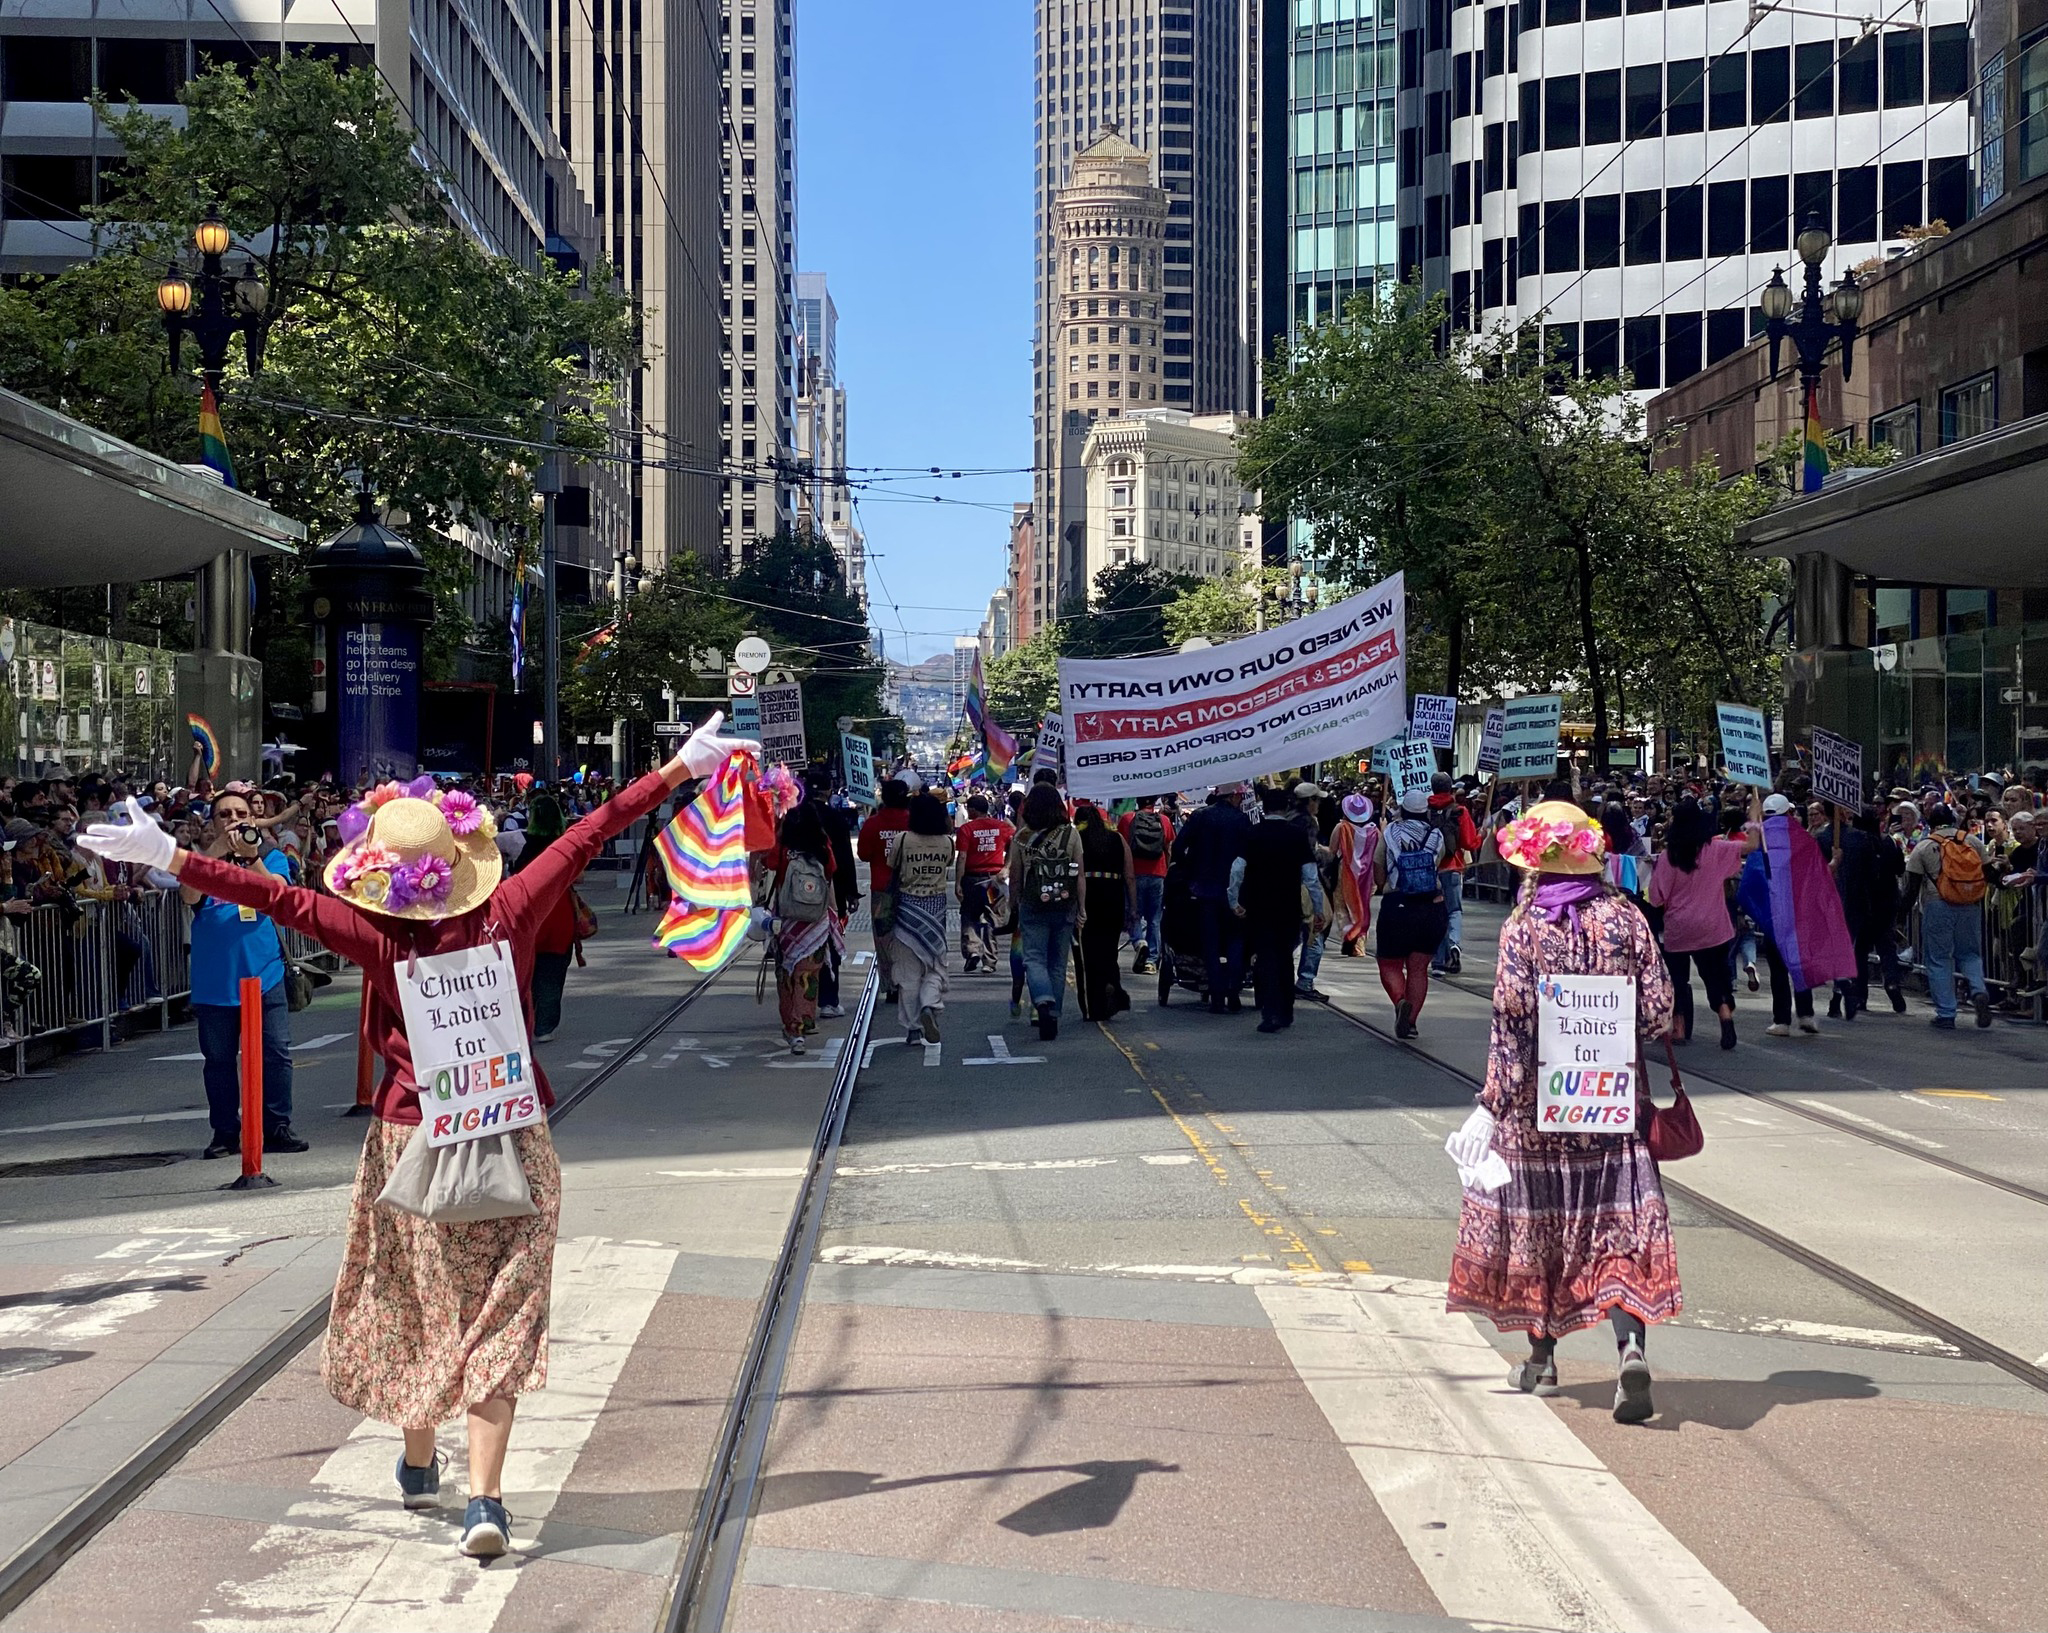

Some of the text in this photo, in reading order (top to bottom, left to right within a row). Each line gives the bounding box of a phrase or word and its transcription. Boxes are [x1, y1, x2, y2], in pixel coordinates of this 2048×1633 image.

[346, 601, 369, 613] SAN
[346, 631, 381, 643] Figma
[346, 644, 407, 657] helps teams
[346, 660, 360, 670] go
[391, 659, 417, 671] design
[346, 671, 400, 684] to delivery
[346, 685, 369, 695] with
[758, 689, 798, 703] RESISTANCE
[767, 701, 799, 712] OCCUPATION
[1416, 697, 1447, 712] FIGHT
[1506, 704, 1557, 716] IMMIGRANT &
[1415, 711, 1453, 722] SOCIALISM
[1424, 721, 1451, 733] LGBTQ
[1487, 721, 1495, 730] LA
[1504, 719, 1556, 731] LGBTQ RIGHTS
[1723, 728, 1742, 739] LGBTQ
[763, 734, 802, 750] STAND WITH
[845, 736, 868, 755] QUEER
[1503, 740, 1554, 752] ONE STRUGGLE
[1815, 733, 1832, 749] FIGHT
[1833, 742, 1859, 761] BIGOTRY
[1390, 742, 1429, 760] QUEER
[1726, 748, 1766, 763] ONE STRUGGLE
[851, 754, 868, 769] AS IN
[1400, 760, 1413, 772] AS
[1416, 756, 1427, 768] IN
[1501, 756, 1521, 769] ONE
[1525, 754, 1554, 766] FIGHT
[1815, 746, 1859, 779] DIVISION
[1728, 761, 1768, 779] ONE FIGHT
[851, 769, 869, 787] END
[1402, 771, 1428, 788] END
[1815, 770, 1859, 808] YOUTH!
[973, 829, 999, 838] SOCIALISM
[977, 844, 996, 852] FUTURE
[906, 854, 947, 862] HUMAN
[912, 866, 942, 875] NEED
[420, 965, 497, 999] Church
[1556, 990, 1619, 1011] Church
[426, 1000, 501, 1031] Ladies
[1558, 1016, 1617, 1035] Ladies
[454, 1037, 486, 1058] for
[1574, 1044, 1600, 1062] for
[435, 1051, 522, 1101] QUEER
[1549, 1071, 1629, 1097] QUEER
[433, 1094, 534, 1139] RIGHTS
[1544, 1105, 1630, 1124] RIGHTS
